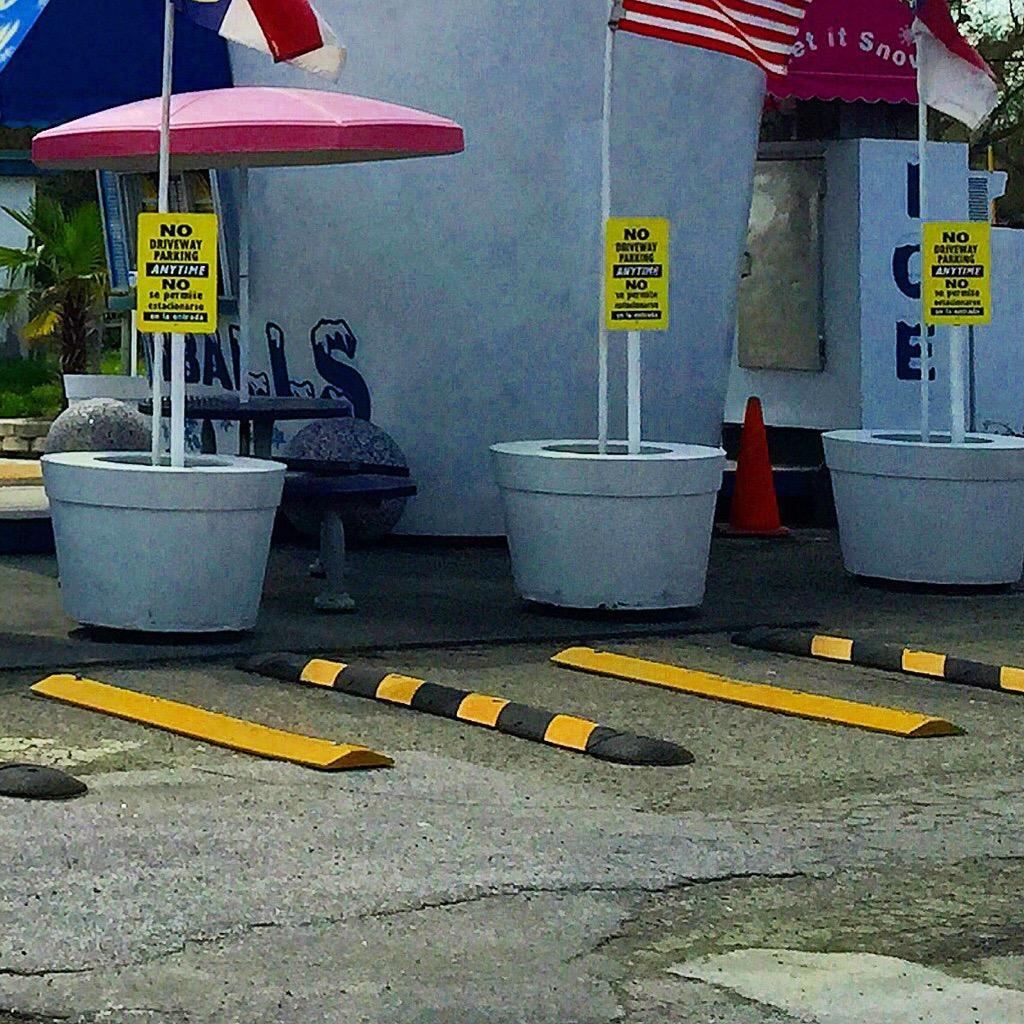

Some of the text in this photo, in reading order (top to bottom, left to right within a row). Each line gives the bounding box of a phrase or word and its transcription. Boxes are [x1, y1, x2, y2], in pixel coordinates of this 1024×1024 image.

[827, 27, 847, 47] it
[160, 224, 193, 237] NO
[624, 228, 649, 240] NO
[942, 232, 969, 243] NO
[150, 239, 202, 250] DRIVEWAY
[154, 251, 198, 261] PARKING
[151, 264, 206, 275] ANYTIME
[936, 266, 982, 276] ANYTIME
[162, 279, 190, 290] NO
[626, 280, 648, 290] NO
[945, 279, 969, 288] NO
[149, 291, 160, 299] se
